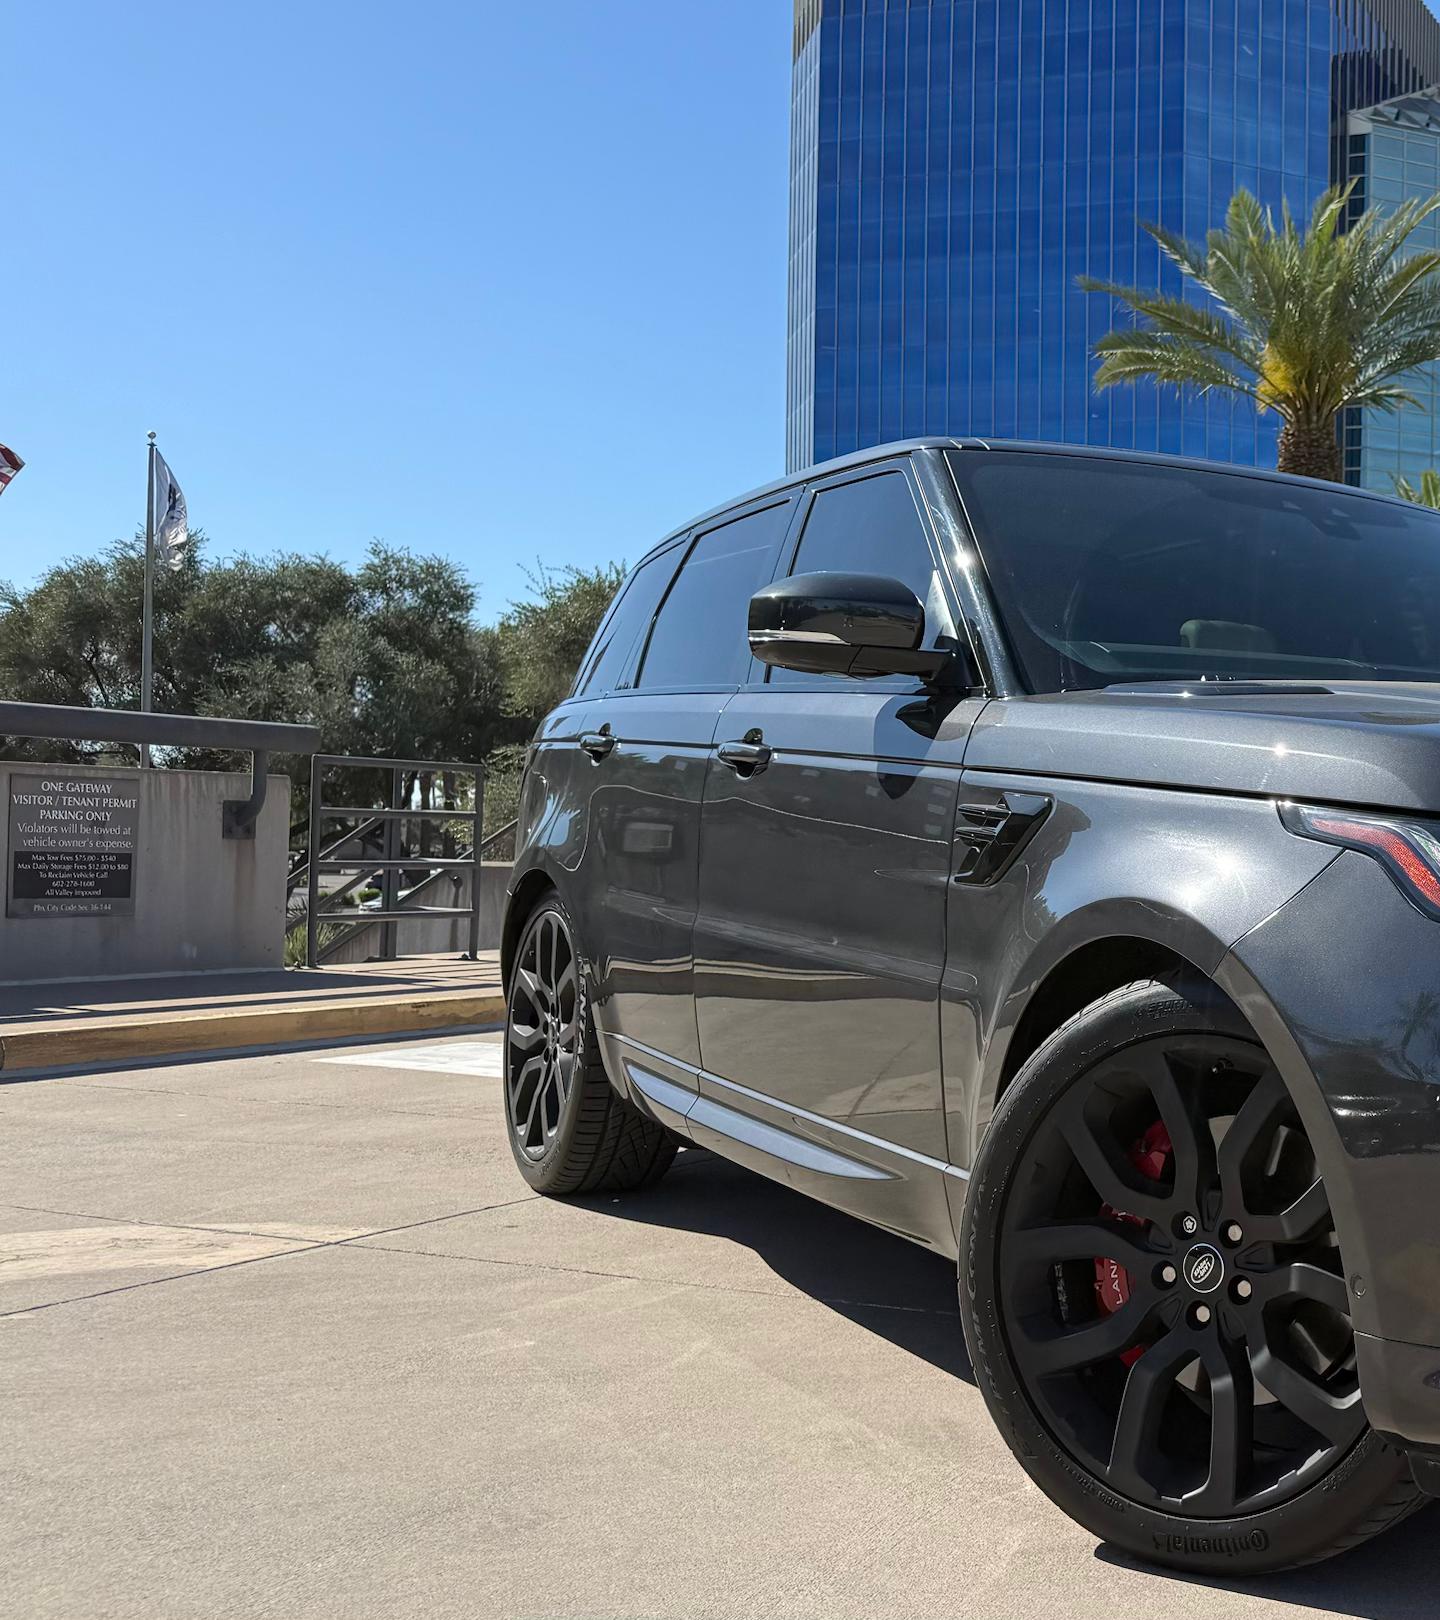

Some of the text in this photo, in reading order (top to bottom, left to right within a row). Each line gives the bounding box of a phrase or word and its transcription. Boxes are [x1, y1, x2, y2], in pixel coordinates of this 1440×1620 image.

[41, 781, 112, 794] ONE GATEWAY
[13, 794, 53, 806] VISITOR
[62, 796, 100, 807] TENANT
[102, 797, 137, 809] PERMIT
[40, 809, 112, 821] PARKING ONLY
[17, 822, 131, 836] Violators will be towed at
[23, 836, 134, 851] vehicle owner's expense.
[32, 863, 49, 871] Daily
[45, 888, 55, 896] All
[55, 888, 73, 897] Valley
[1110, 1259, 1123, 1305] LAN
